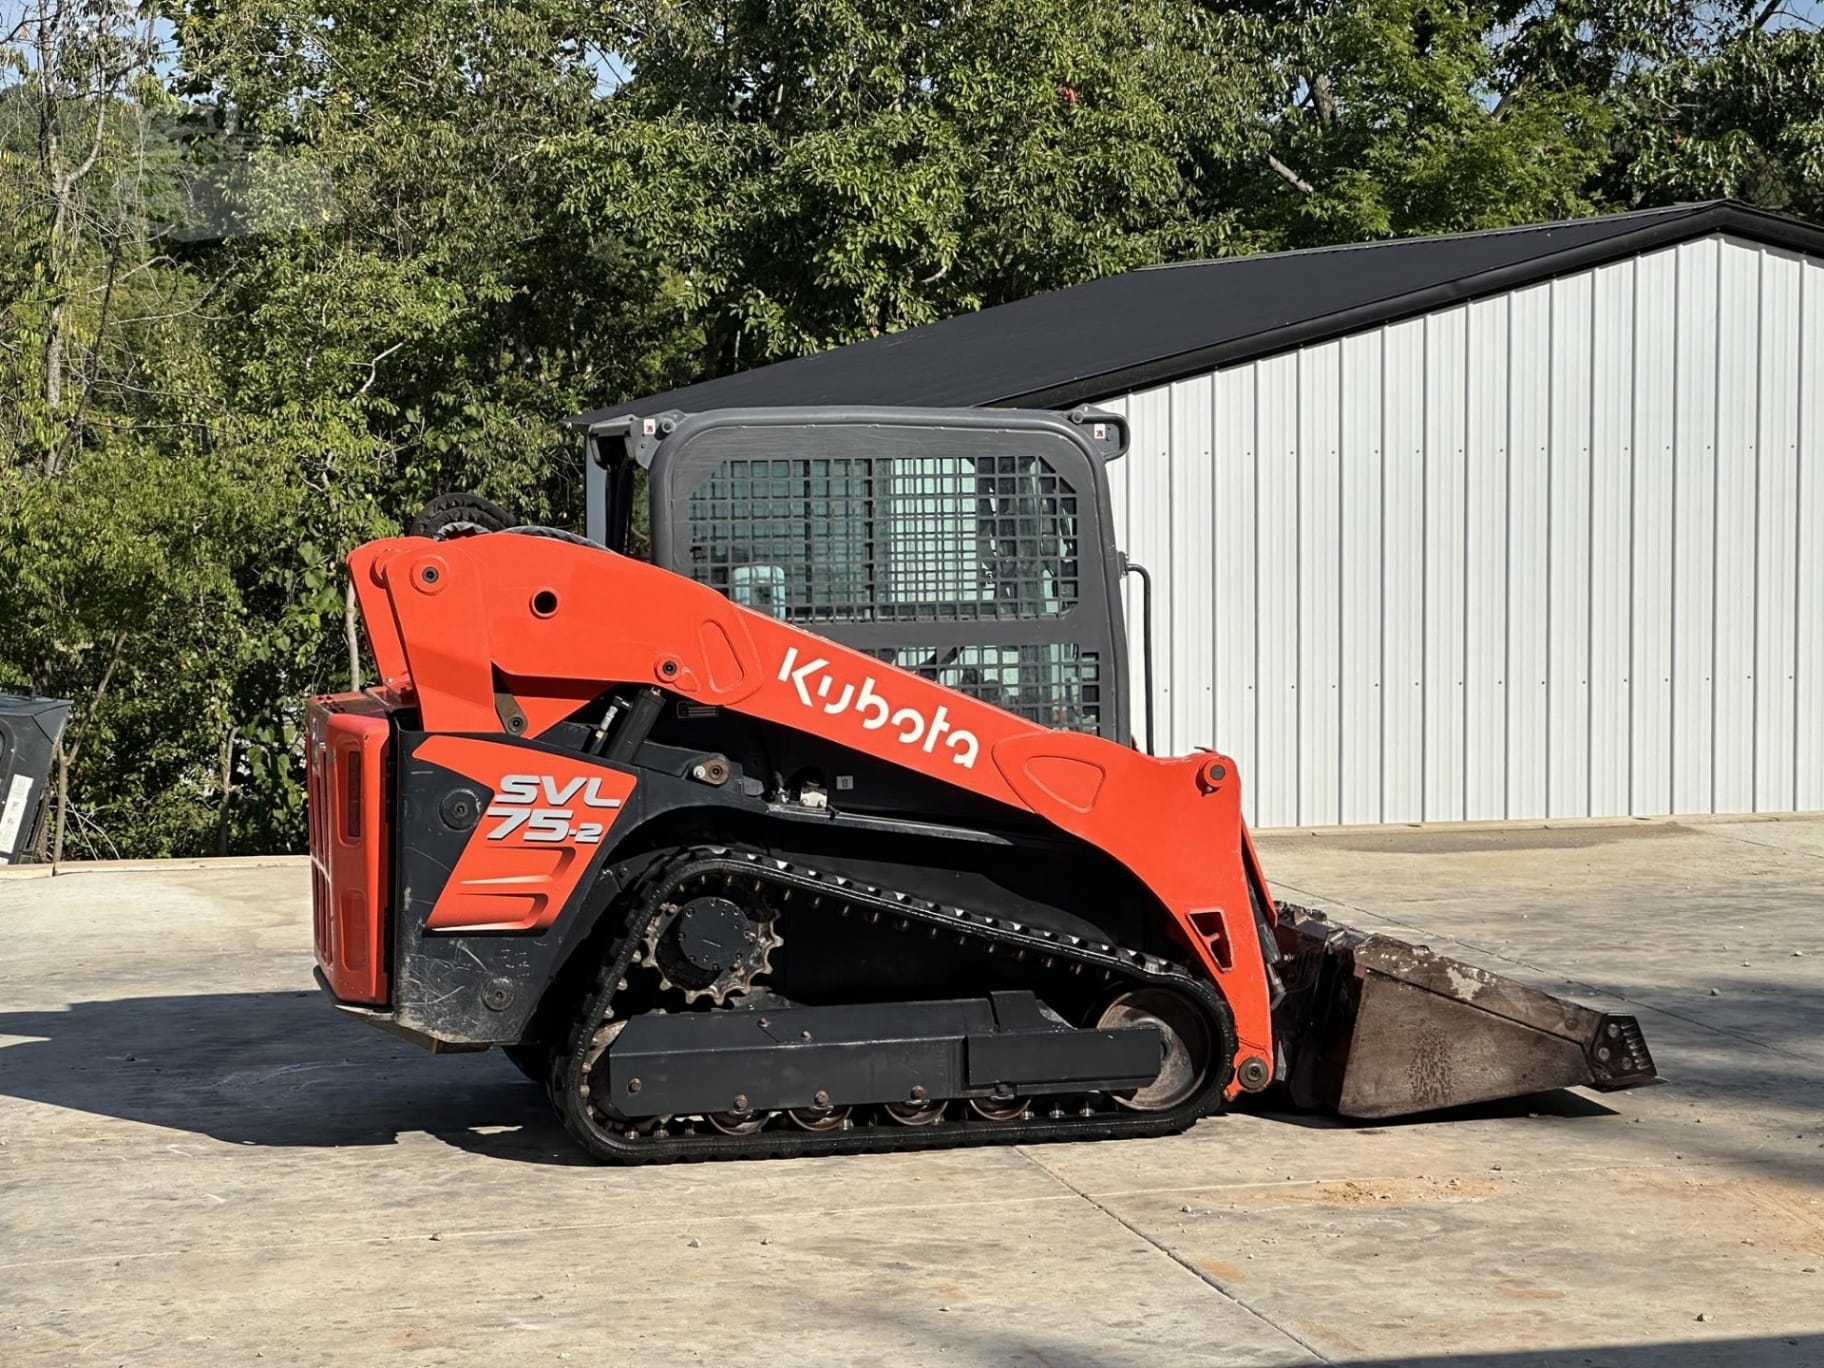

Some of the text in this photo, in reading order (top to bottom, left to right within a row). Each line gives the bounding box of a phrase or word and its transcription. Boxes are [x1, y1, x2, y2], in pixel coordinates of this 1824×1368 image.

[777, 646, 980, 769] Kubota
[494, 774, 622, 807] SVL
[486, 806, 603, 843] 75-2
